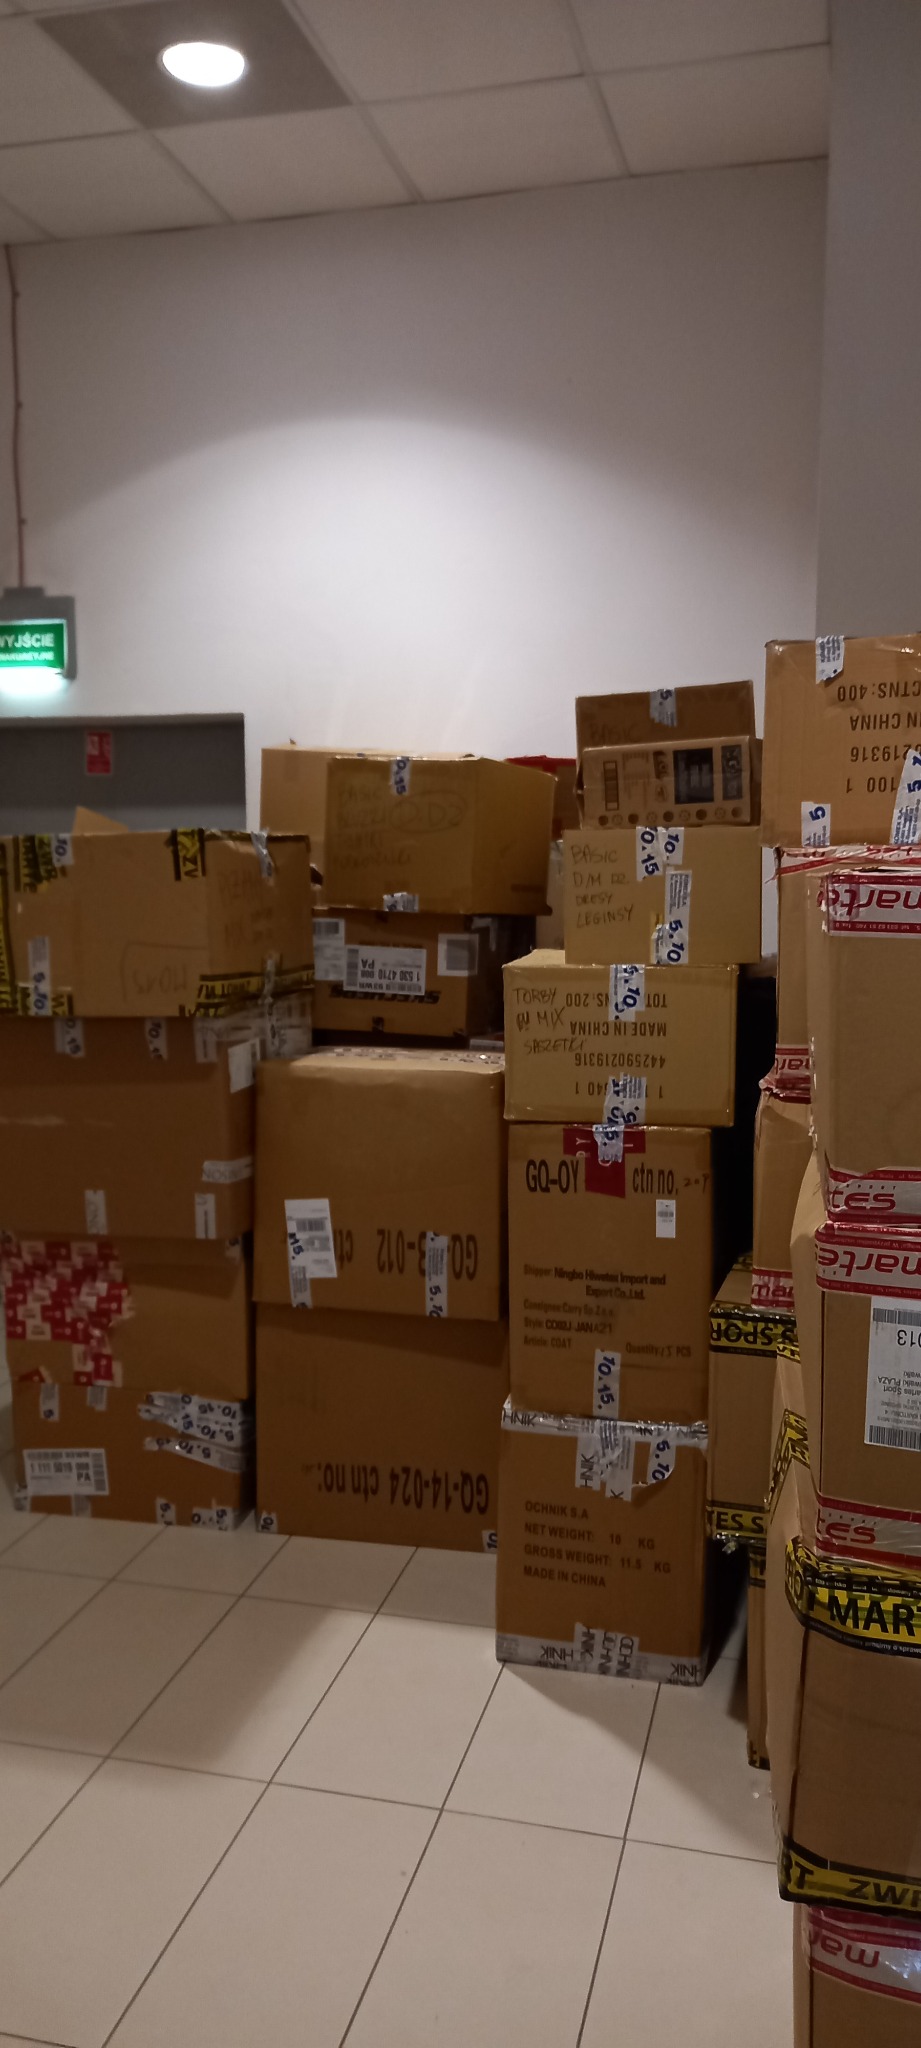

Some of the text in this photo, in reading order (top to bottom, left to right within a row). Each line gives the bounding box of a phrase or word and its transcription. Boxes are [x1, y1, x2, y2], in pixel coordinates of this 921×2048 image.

[850, 713, 901, 731] CHINA
[571, 844, 619, 864] BASIC
[361, 959, 375, 969] PA
[569, 1021, 667, 1037] MADE IN CHINA
[574, 1053, 666, 1069] 442590219316
[632, 1162, 654, 1195] ctn
[554, 1266, 584, 1282] Ningbo
[619, 1271, 649, 1286] Import
[649, 1273, 667, 1286] and
[550, 1337, 572, 1349] COAT
[883, 1385, 902, 1395] Sport
[389, 1466, 491, 1516] GQ-14-024
[525, 1500, 568, 1518] OCHNIK
[524, 1522, 547, 1537] NET
[638, 1536, 656, 1550] KG
[524, 1543, 564, 1560] GROSS
[654, 1560, 672, 1574] KG
[523, 1564, 607, 1588] MADE IN CHINA
[828, 1594, 921, 1638] MAR
